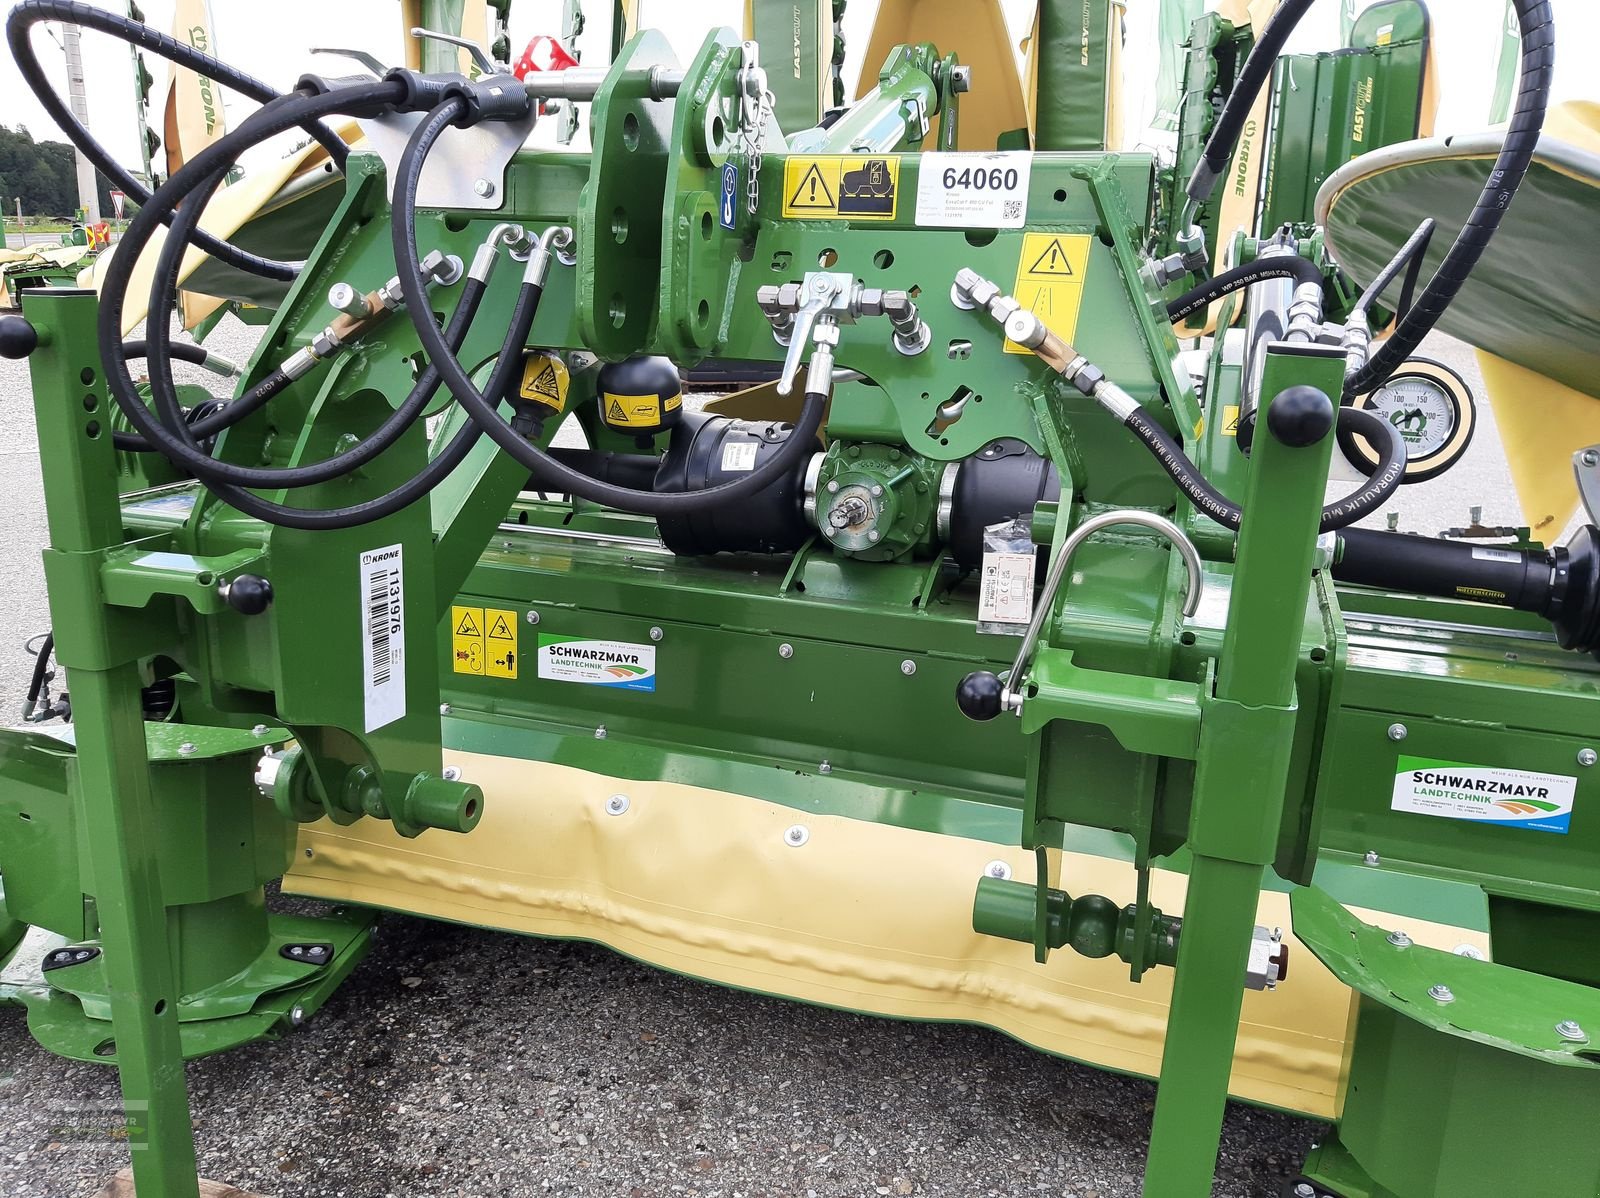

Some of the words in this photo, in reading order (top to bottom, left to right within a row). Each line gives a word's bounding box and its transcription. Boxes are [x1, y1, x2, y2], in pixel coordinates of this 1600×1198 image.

[793, 5, 801, 80] EASYCUT
[1352, 80, 1367, 142] EASYCUT
[943, 167, 1018, 191] 64060
[1235, 139, 1251, 198] KRONE
[1221, 282, 1234, 292] WP
[1234, 278, 1245, 288] 250
[1245, 273, 1259, 284] BAR
[1393, 395, 1405, 403] 100
[1425, 412, 1437, 420] 200
[1139, 419, 1153, 440] WP
[1164, 454, 1182, 476] DN10
[1189, 484, 1205, 502] 2SN
[1345, 462, 1401, 513] HYDRAULIK
[1202, 496, 1228, 518] EN853
[372, 550, 400, 564] KRONE
[389, 567, 401, 635] 1131976
[549, 645, 639, 664] SCHWARZMAYR
[551, 658, 603, 670] LANDTECHNIK
[1413, 771, 1549, 799] SCHWARZMAYR
[1413, 786, 1492, 804] LANDTECHNIK
